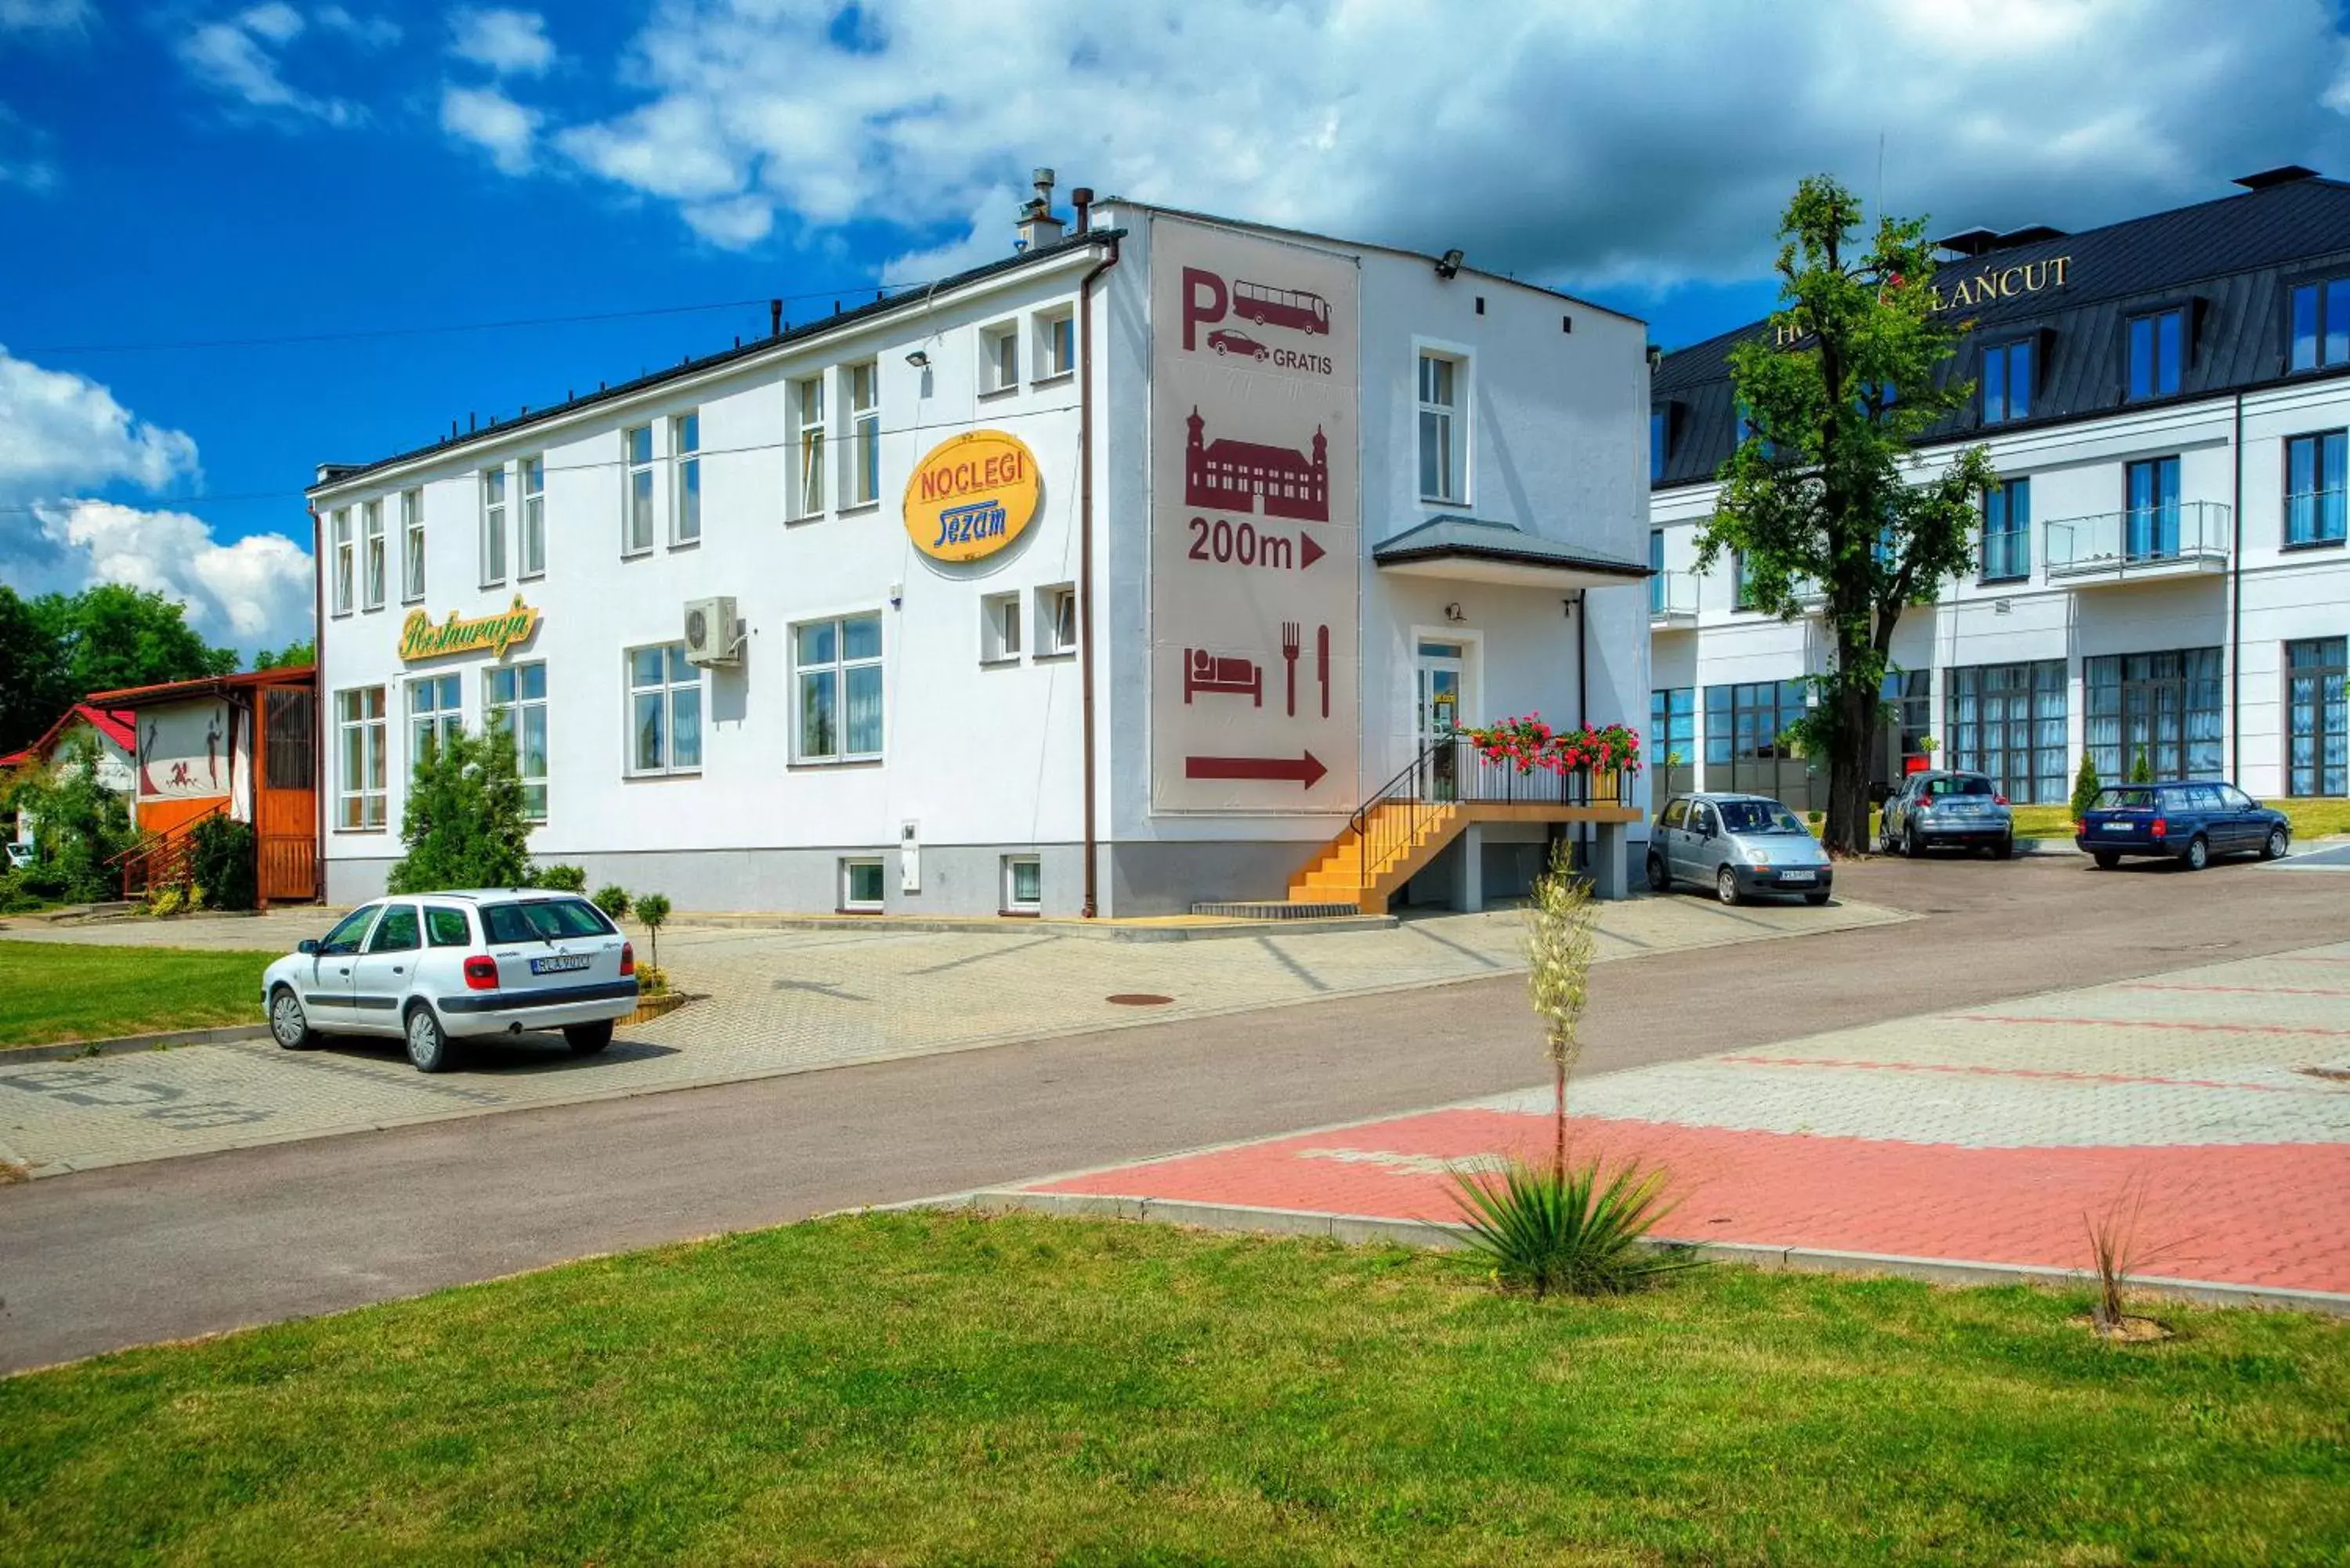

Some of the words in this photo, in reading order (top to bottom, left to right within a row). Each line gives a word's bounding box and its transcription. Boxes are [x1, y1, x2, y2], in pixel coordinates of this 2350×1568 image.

[1183, 266, 1228, 351] P
[1273, 349, 1332, 375] GRATIS
[920, 451, 1023, 500] NOCLEGI
[934, 500, 1005, 547] Sezam
[1188, 517, 1292, 569] 200m
